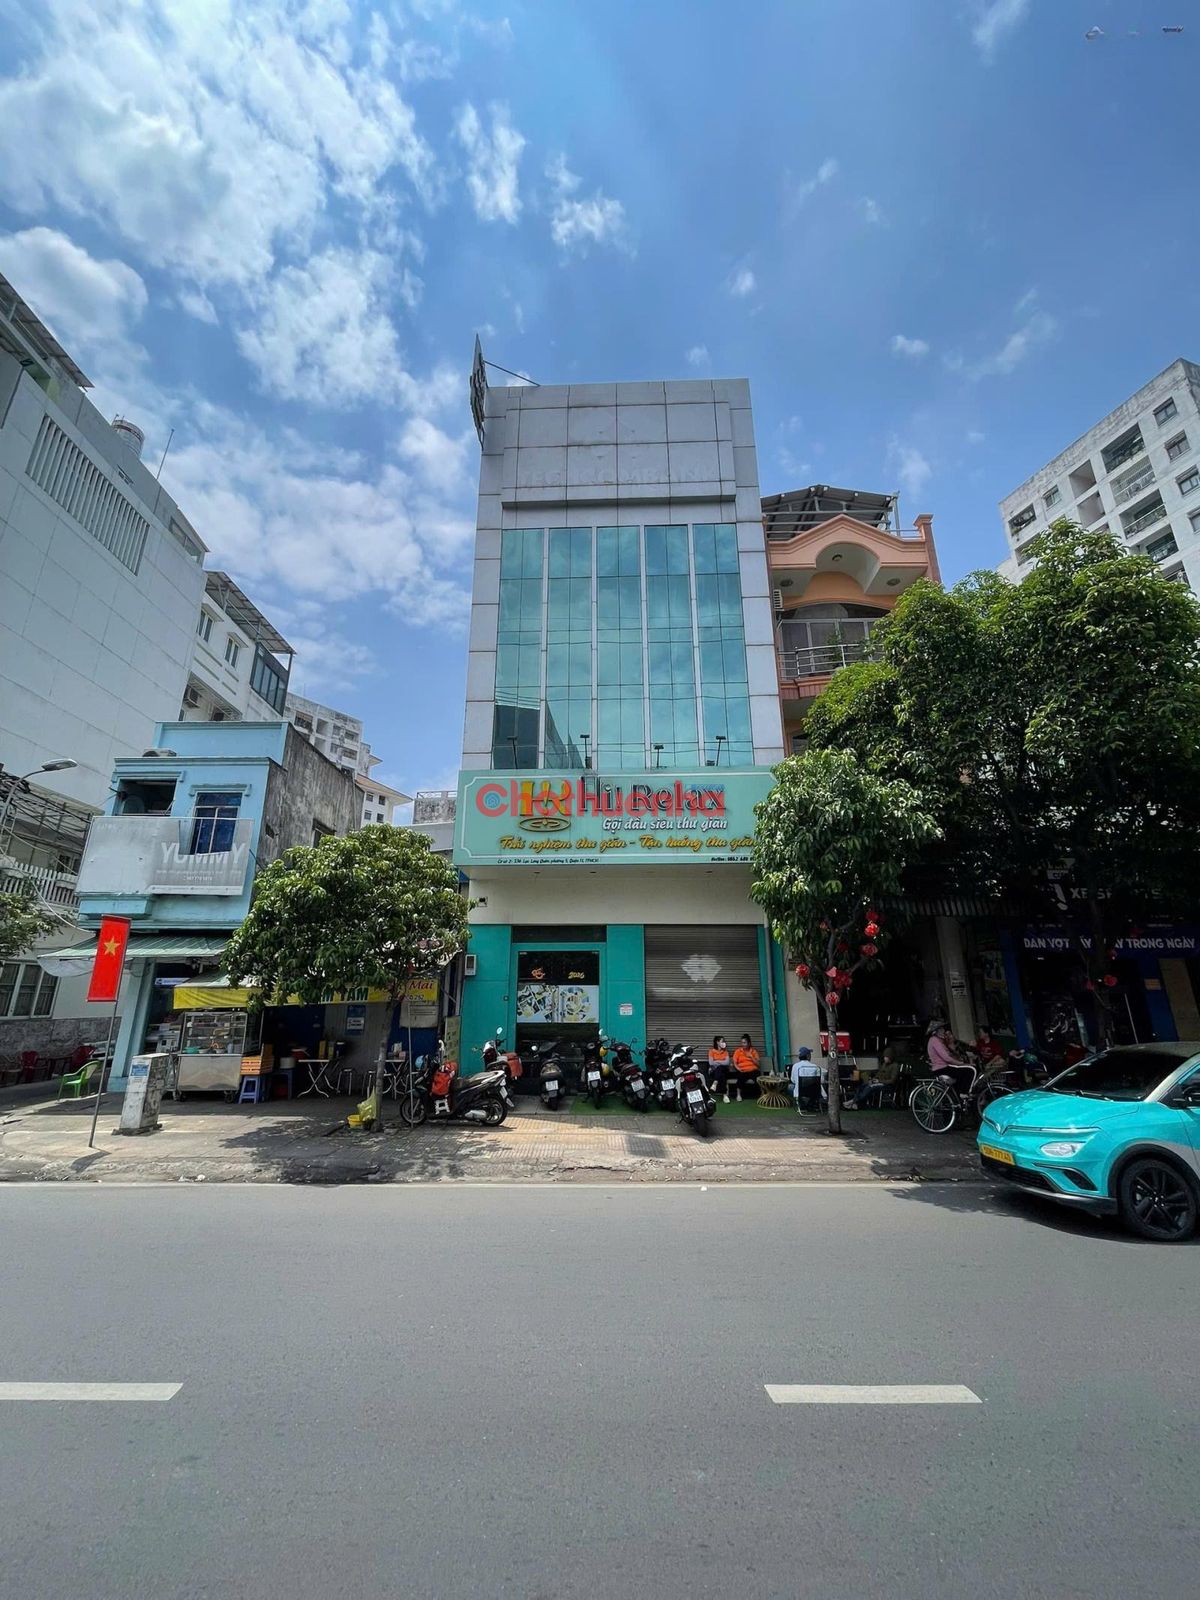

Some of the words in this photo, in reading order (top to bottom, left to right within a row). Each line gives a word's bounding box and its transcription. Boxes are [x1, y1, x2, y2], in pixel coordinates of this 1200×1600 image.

[631, 783, 726, 812] Relax
[603, 818, 621, 834] Gội
[624, 817, 647, 830] đầu
[650, 818, 673, 830] siêu
[701, 817, 728, 832] giãn
[1125, 937, 1164, 949] TRONG
